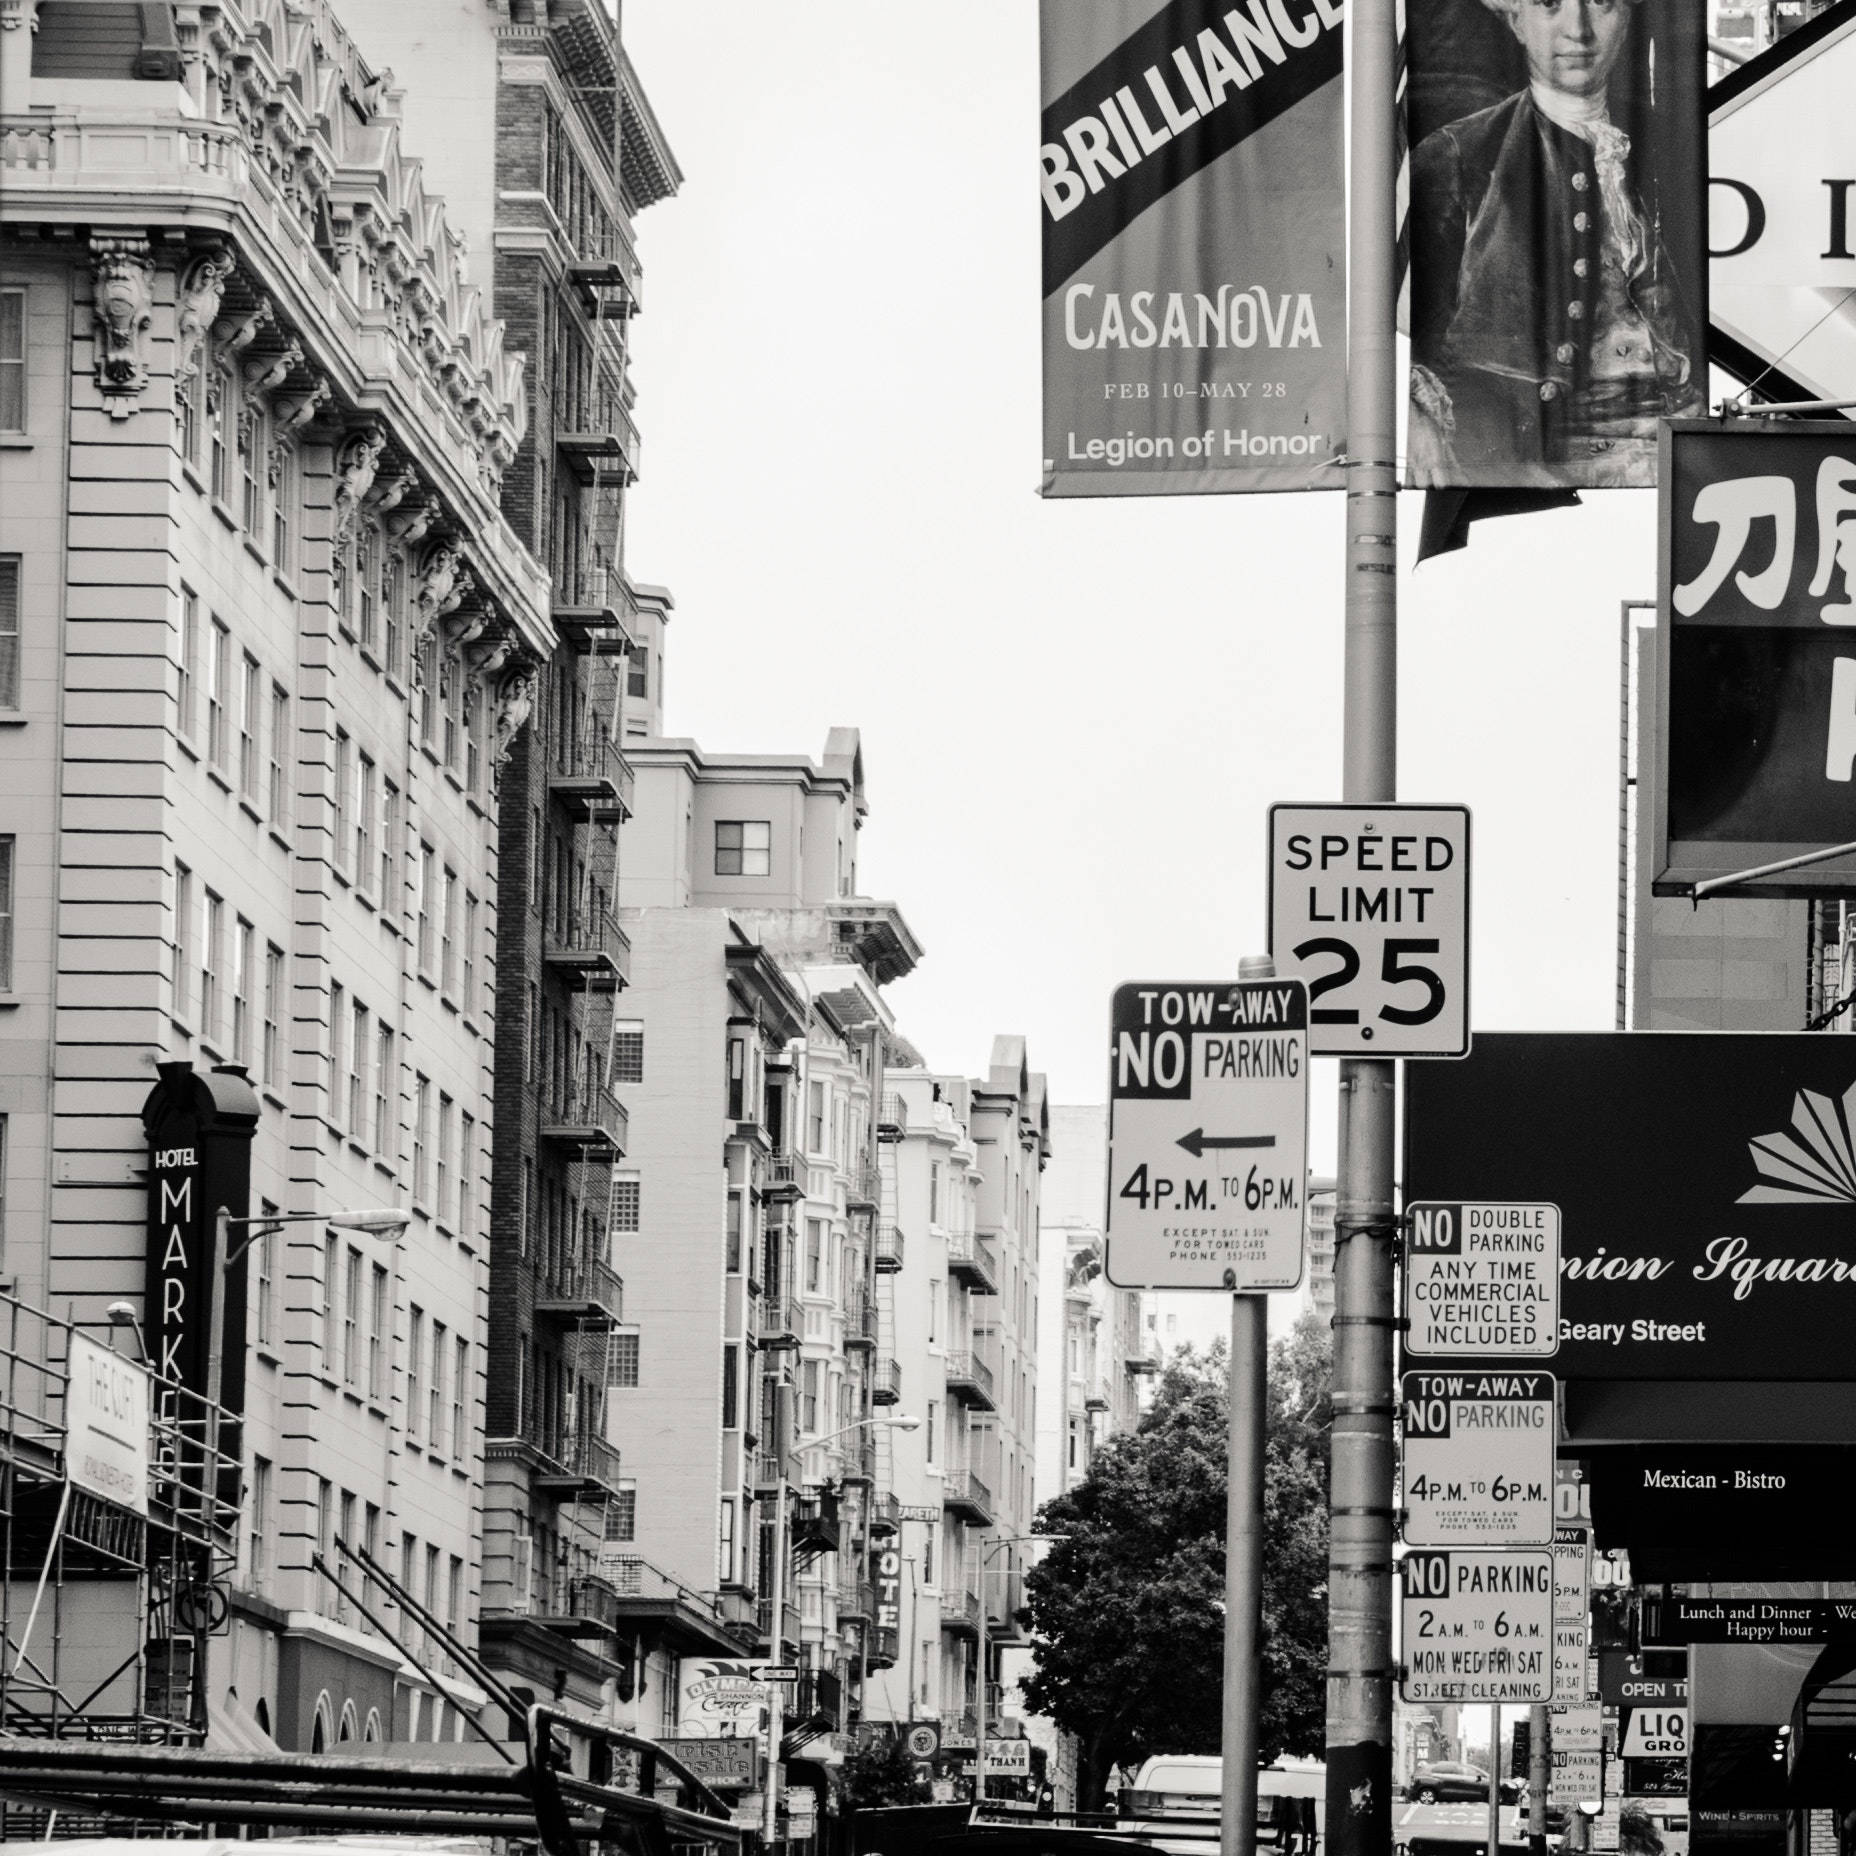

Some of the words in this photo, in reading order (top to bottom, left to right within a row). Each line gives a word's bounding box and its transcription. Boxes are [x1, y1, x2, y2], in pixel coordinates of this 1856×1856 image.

[1063, 282, 1322, 350] CASANOVA
[1103, 381, 1152, 400] FEB
[1261, 380, 1288, 399] 28
[1067, 431, 1175, 466] Legion
[1182, 430, 1216, 459] of
[1223, 430, 1322, 458] Honor
[1285, 835, 1454, 872] SPEED
[1309, 887, 1434, 923] LIMIT
[1292, 937, 1446, 1026] 25
[1138, 990, 1294, 1027] TOW-AWAY
[1117, 1030, 1185, 1090] NO
[1204, 1038, 1299, 1080] PARKING
[155, 1148, 199, 1168] HOTEL
[1221, 1177, 1240, 1199] TO
[1414, 1209, 1453, 1248] NO
[1470, 1210, 1545, 1229] DOUBLE
[1163, 1228, 1217, 1237] EXCEPT
[1174, 1240, 1200, 1249] FOR
[1208, 1240, 1239, 1249] TOWED
[1243, 1240, 1265, 1249] CARS
[1470, 1234, 1545, 1252] PARKING
[1169, 1251, 1217, 1260] PHONE
[1430, 1262, 1477, 1280] ANY
[1488, 1262, 1536, 1280] TIME
[1415, 1283, 1550, 1301] COMMERCIAL
[1430, 1305, 1536, 1323] VEHICLES
[1427, 1326, 1537, 1344] INCLUDED
[1558, 1319, 1625, 1345] Geary
[1631, 1319, 1705, 1342] Street
[1418, 1377, 1539, 1397] TOW-AWAY
[1407, 1399, 1447, 1433] NO
[1456, 1406, 1545, 1428] PARKING
[1471, 1482, 1486, 1494] TO
[1643, 1469, 1717, 1488] Mexican
[1733, 1469, 1786, 1489] Bistro
[1408, 1558, 1446, 1595] NO
[1458, 1566, 1550, 1593] PARKING
[1680, 1605, 1725, 1621] Lunch
[1730, 1605, 1756, 1621] and
[1761, 1605, 1812, 1621] Dinner
[1474, 1620, 1485, 1630] TO
[1727, 1622, 1775, 1639] Happy
[1779, 1622, 1814, 1637] hour
[1413, 1651, 1445, 1674] MON
[1451, 1651, 1482, 1674] WED
[1489, 1651, 1512, 1674] FRI
[1518, 1651, 1543, 1674] SAT
[1414, 1683, 1466, 1698] STREET
[1471, 1683, 1541, 1697] CLEANING
[1622, 1683, 1665, 1696] OPEN
[1552, 1752, 1567, 1766] NO
[1568, 1756, 1599, 1766] PARKING
[1739, 1811, 1779, 1821] SPIRITS
